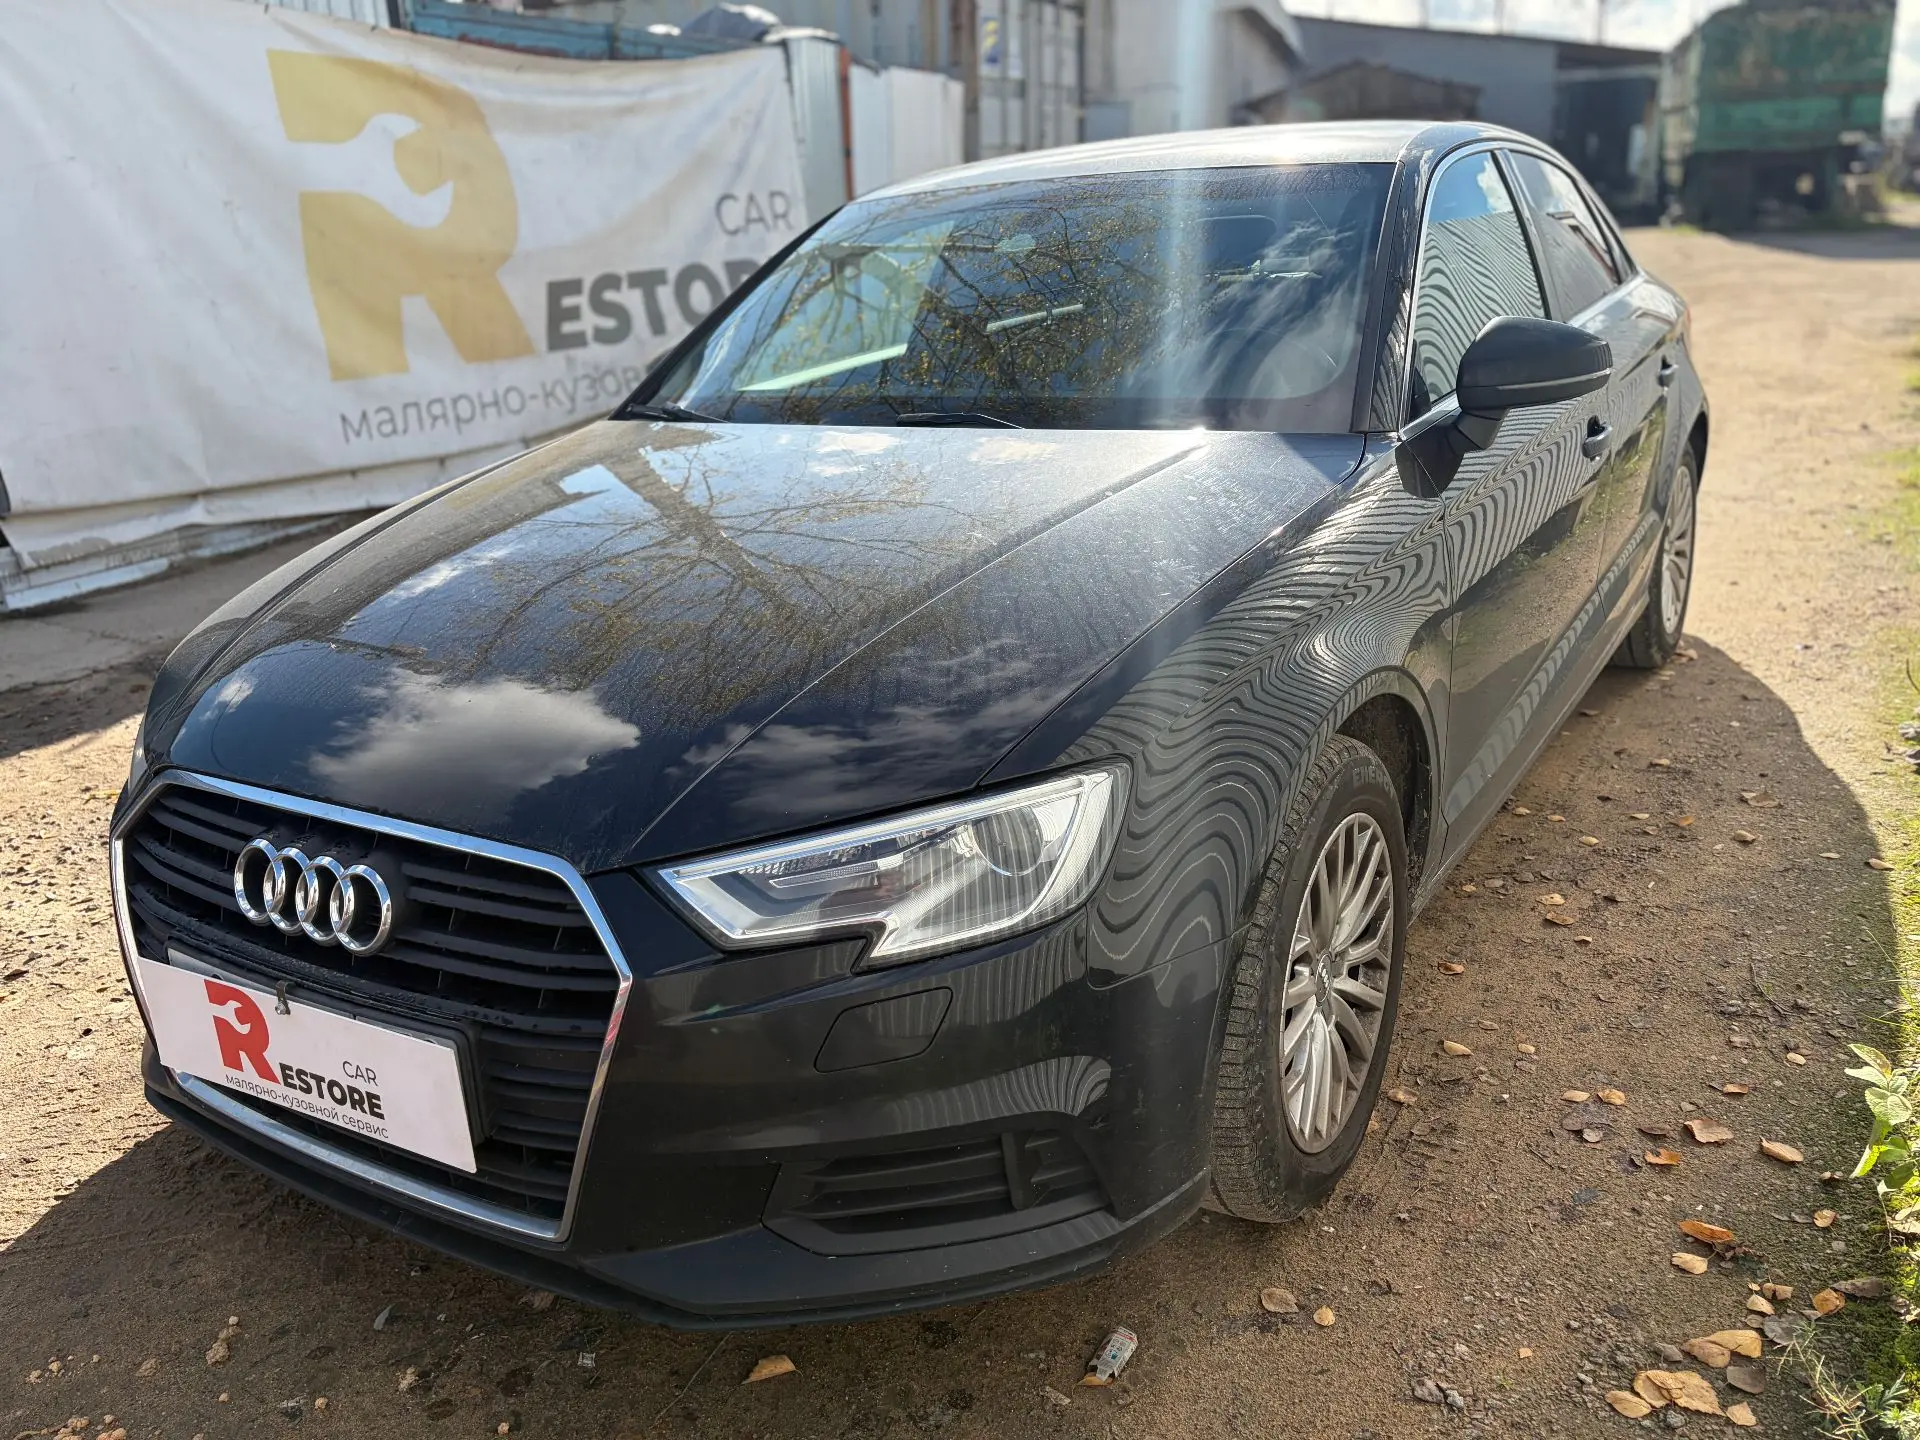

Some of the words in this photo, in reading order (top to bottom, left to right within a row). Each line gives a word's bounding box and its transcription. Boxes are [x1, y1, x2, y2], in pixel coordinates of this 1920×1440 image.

[715, 190, 795, 236] CAR
[342, 1060, 378, 1087] CAR
[225, 1074, 340, 1122] малярно-кузовной
[341, 1111, 389, 1139] сервис
